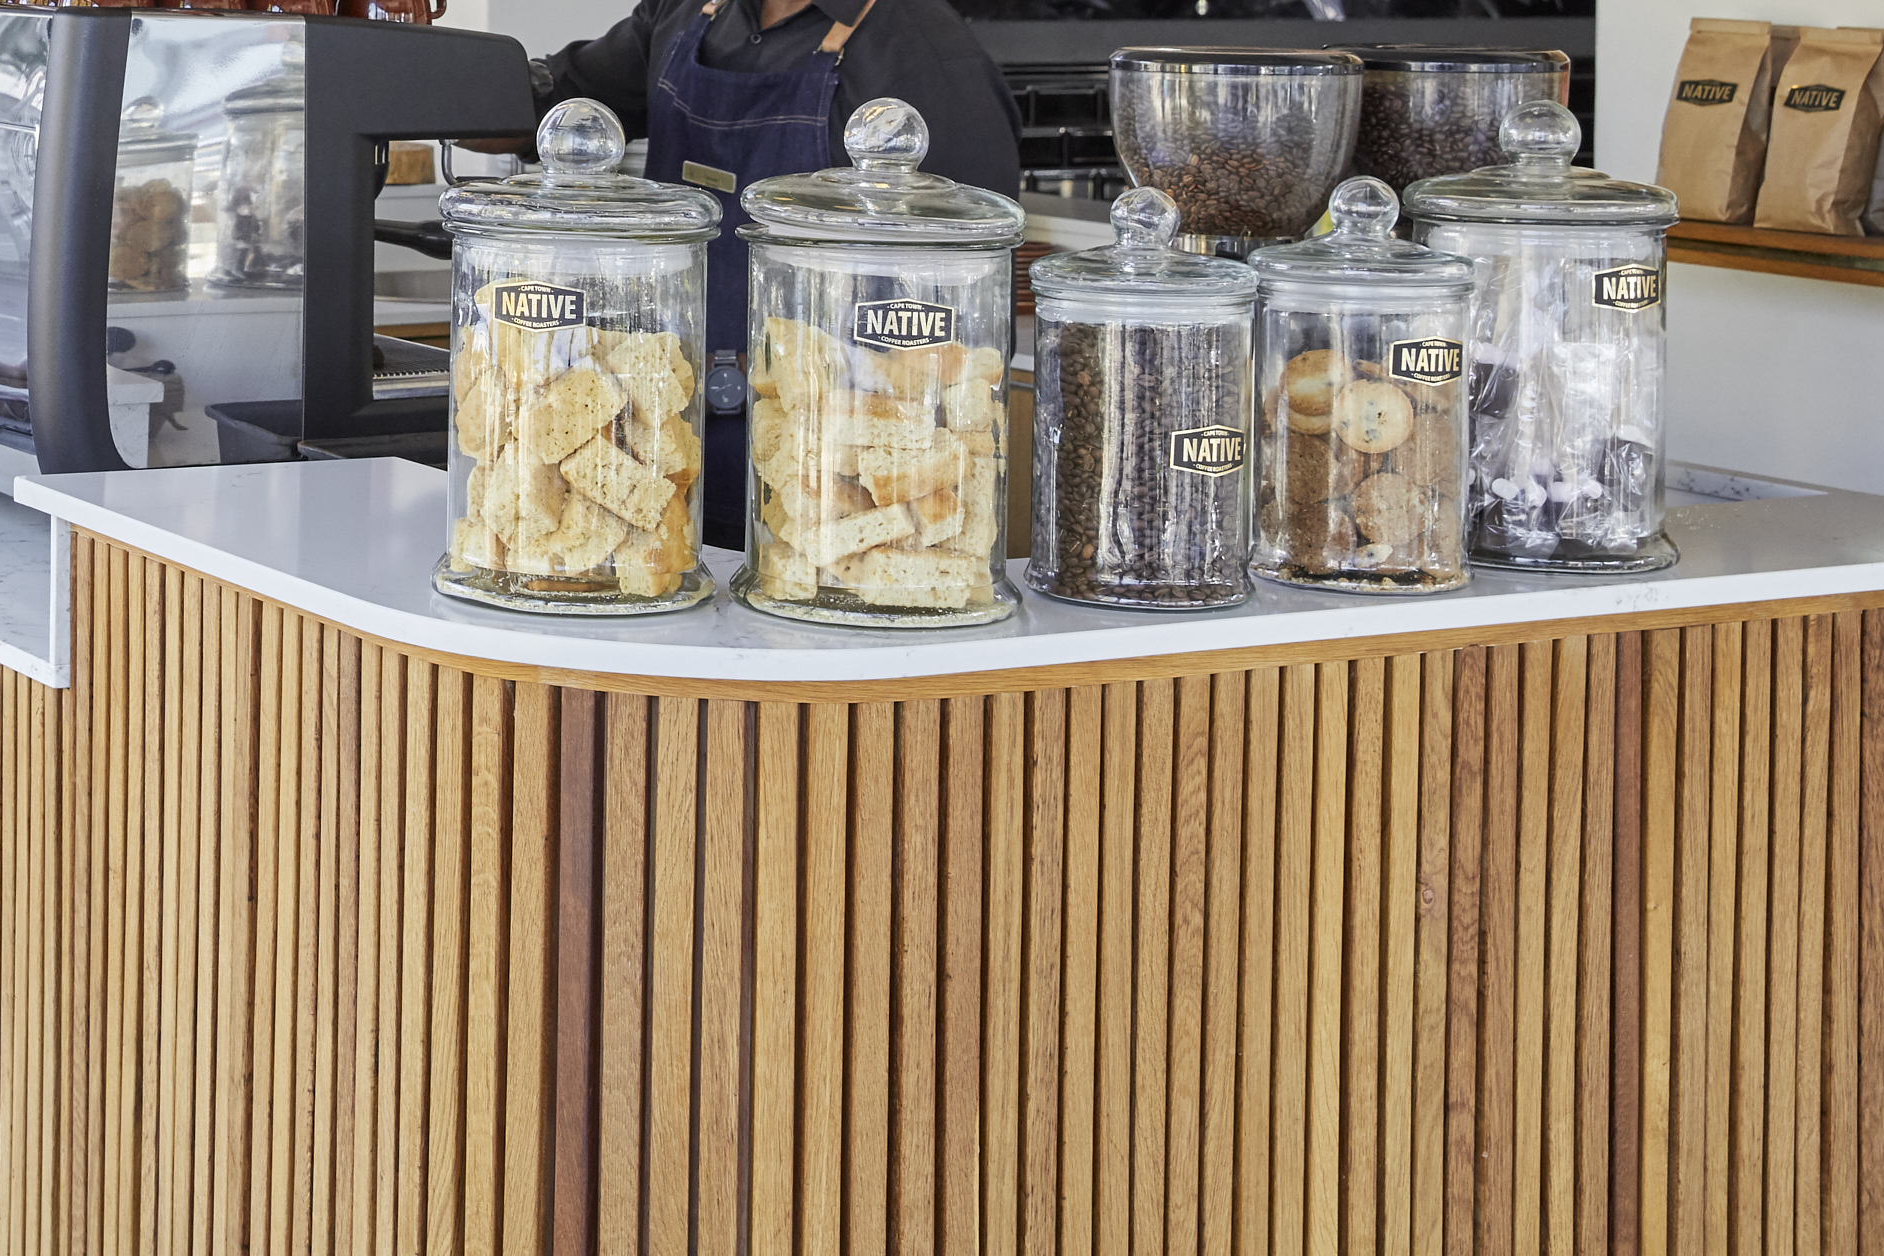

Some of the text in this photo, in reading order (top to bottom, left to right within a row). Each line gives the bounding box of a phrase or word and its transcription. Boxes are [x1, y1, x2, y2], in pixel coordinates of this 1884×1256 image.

[1682, 83, 1733, 100] NATIVE
[1790, 90, 1840, 107] NATIVE
[1602, 275, 1656, 300] NATIVE
[501, 291, 577, 320] NATIVE
[906, 303, 922, 311] TOWN
[513, 317, 560, 328] COFFEE ROASTERS
[866, 309, 946, 337] NATIVE
[881, 336, 930, 346] COFFEE ROASTERS
[1400, 347, 1460, 372] NATIVE
[1182, 437, 1242, 462] NATIVE
